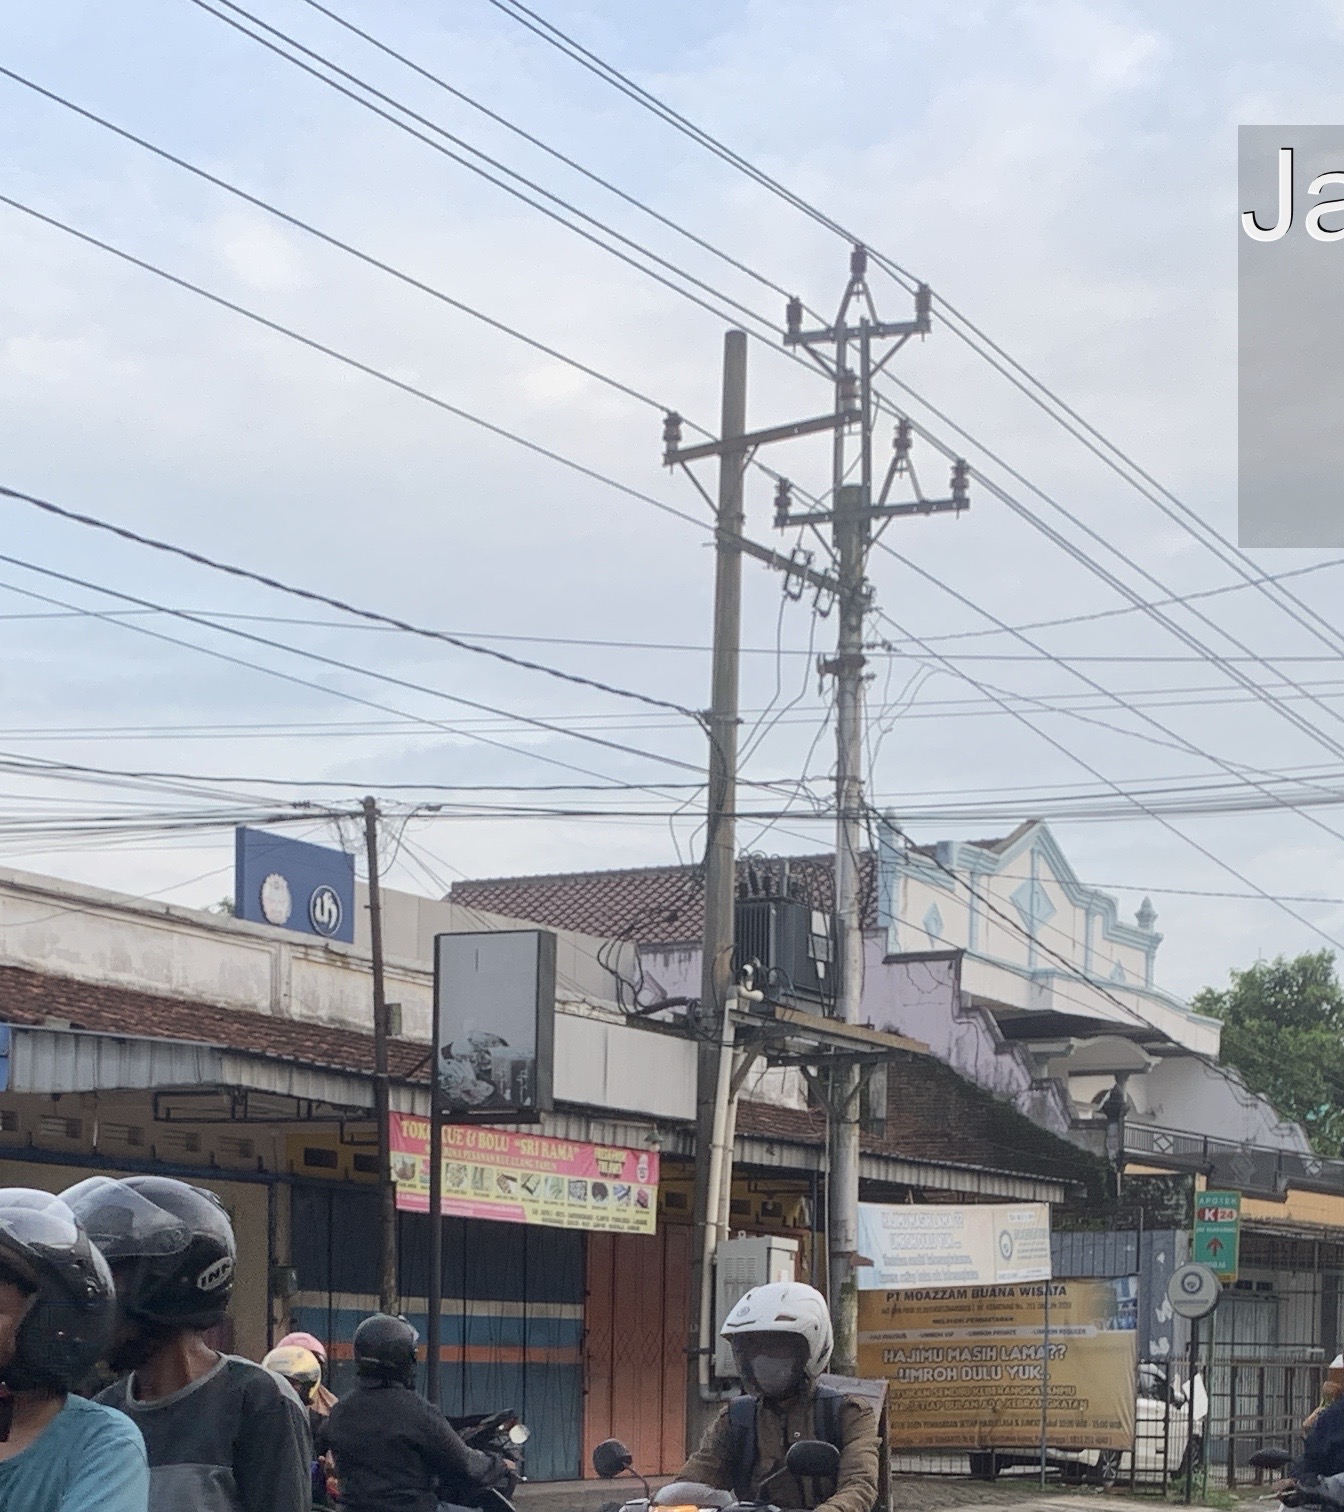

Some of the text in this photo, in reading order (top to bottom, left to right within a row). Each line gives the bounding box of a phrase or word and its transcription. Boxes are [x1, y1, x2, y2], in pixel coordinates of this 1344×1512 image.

[478, 1130, 510, 1153] BOLU
[886, 1285, 1067, 1301] PT MOAZZAM BUANA WISATA
[883, 1349, 944, 1365] HAJIMU
[947, 1347, 998, 1363] MASIH
[898, 1367, 957, 1383] UMROH
[960, 1366, 1002, 1381] DULU
